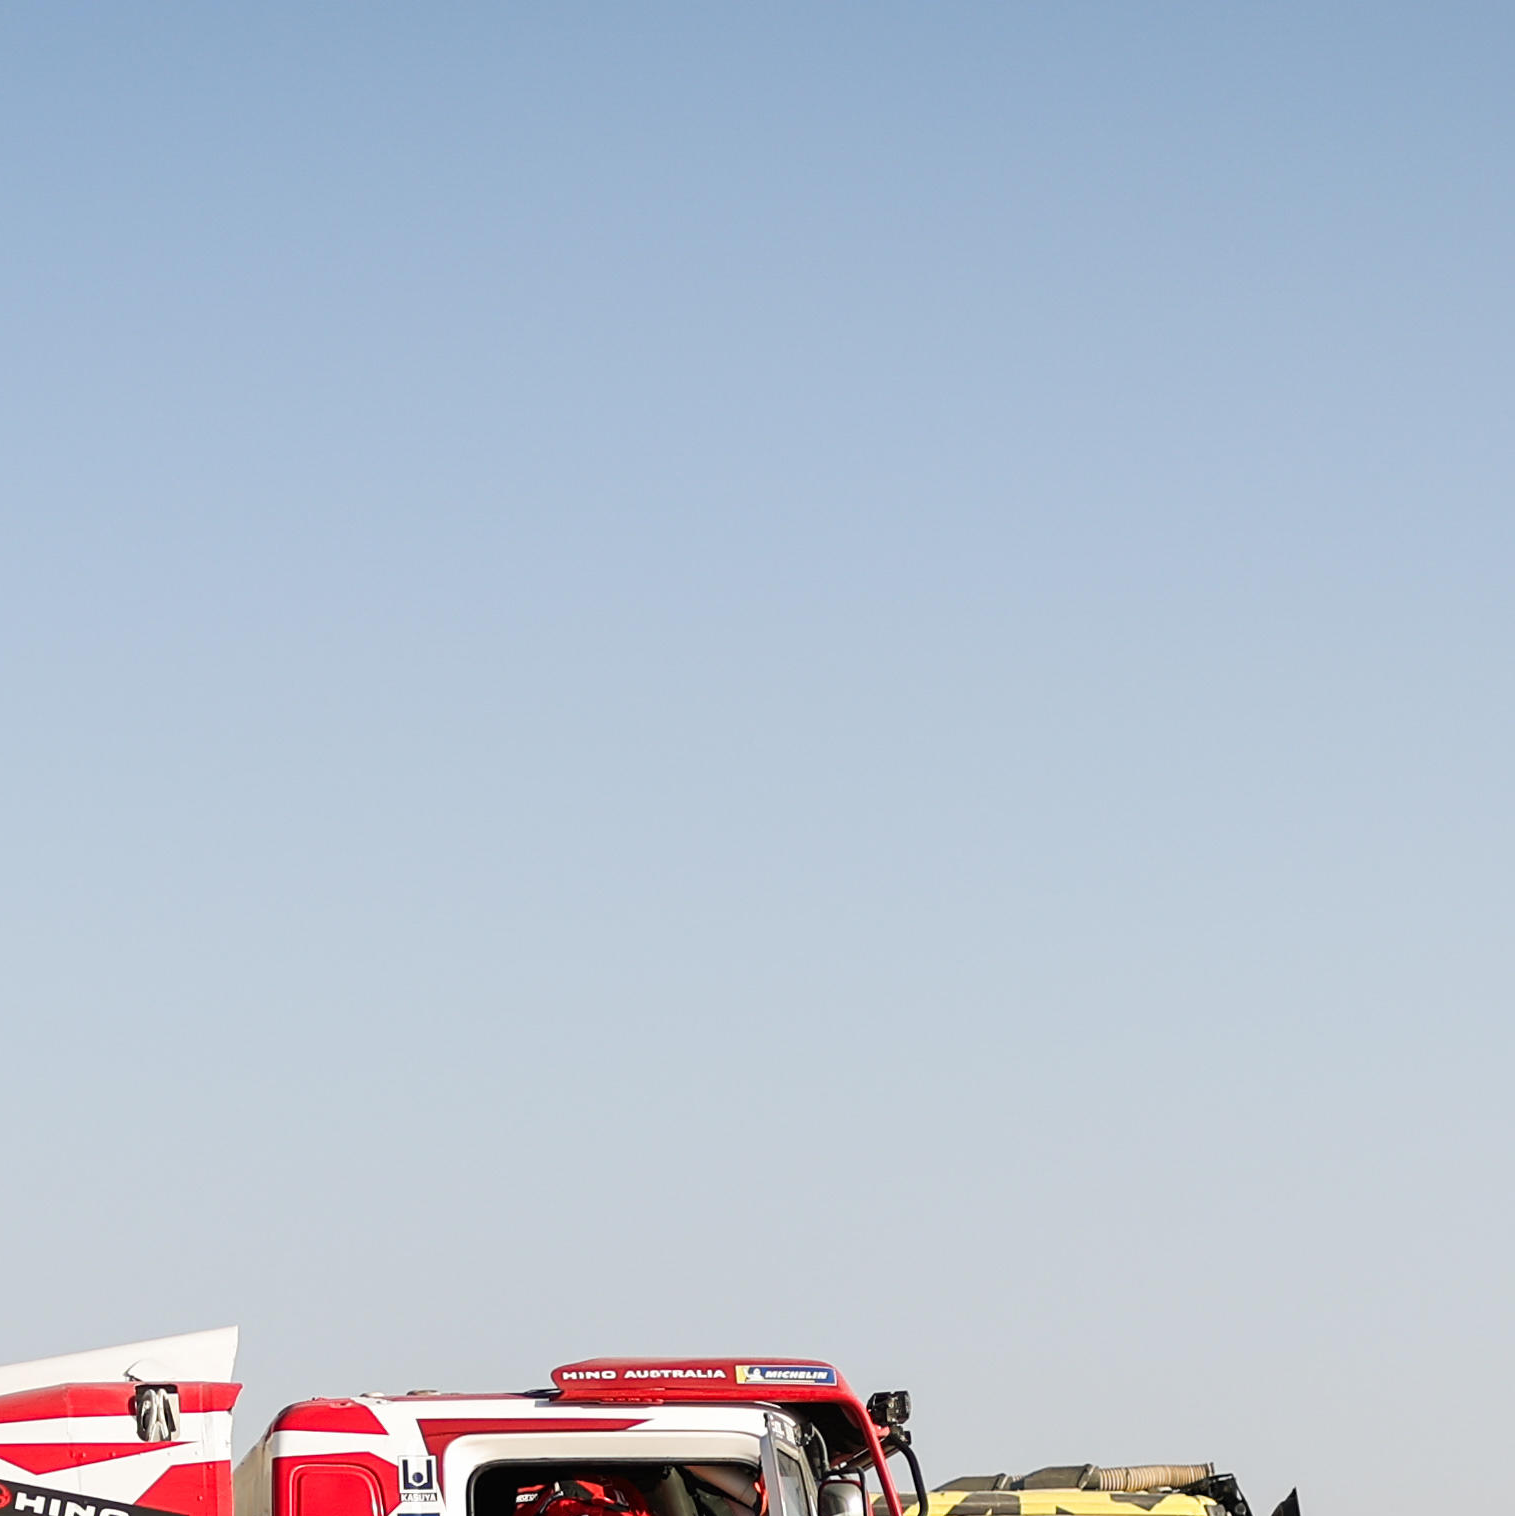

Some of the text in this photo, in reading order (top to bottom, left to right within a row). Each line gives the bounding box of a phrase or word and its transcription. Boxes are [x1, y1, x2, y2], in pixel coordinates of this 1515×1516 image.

[562, 1369, 727, 1380] HINO AUSTRALIA
[765, 1370, 828, 1380] MICHELIN
[401, 1493, 437, 1502] KASUYA
